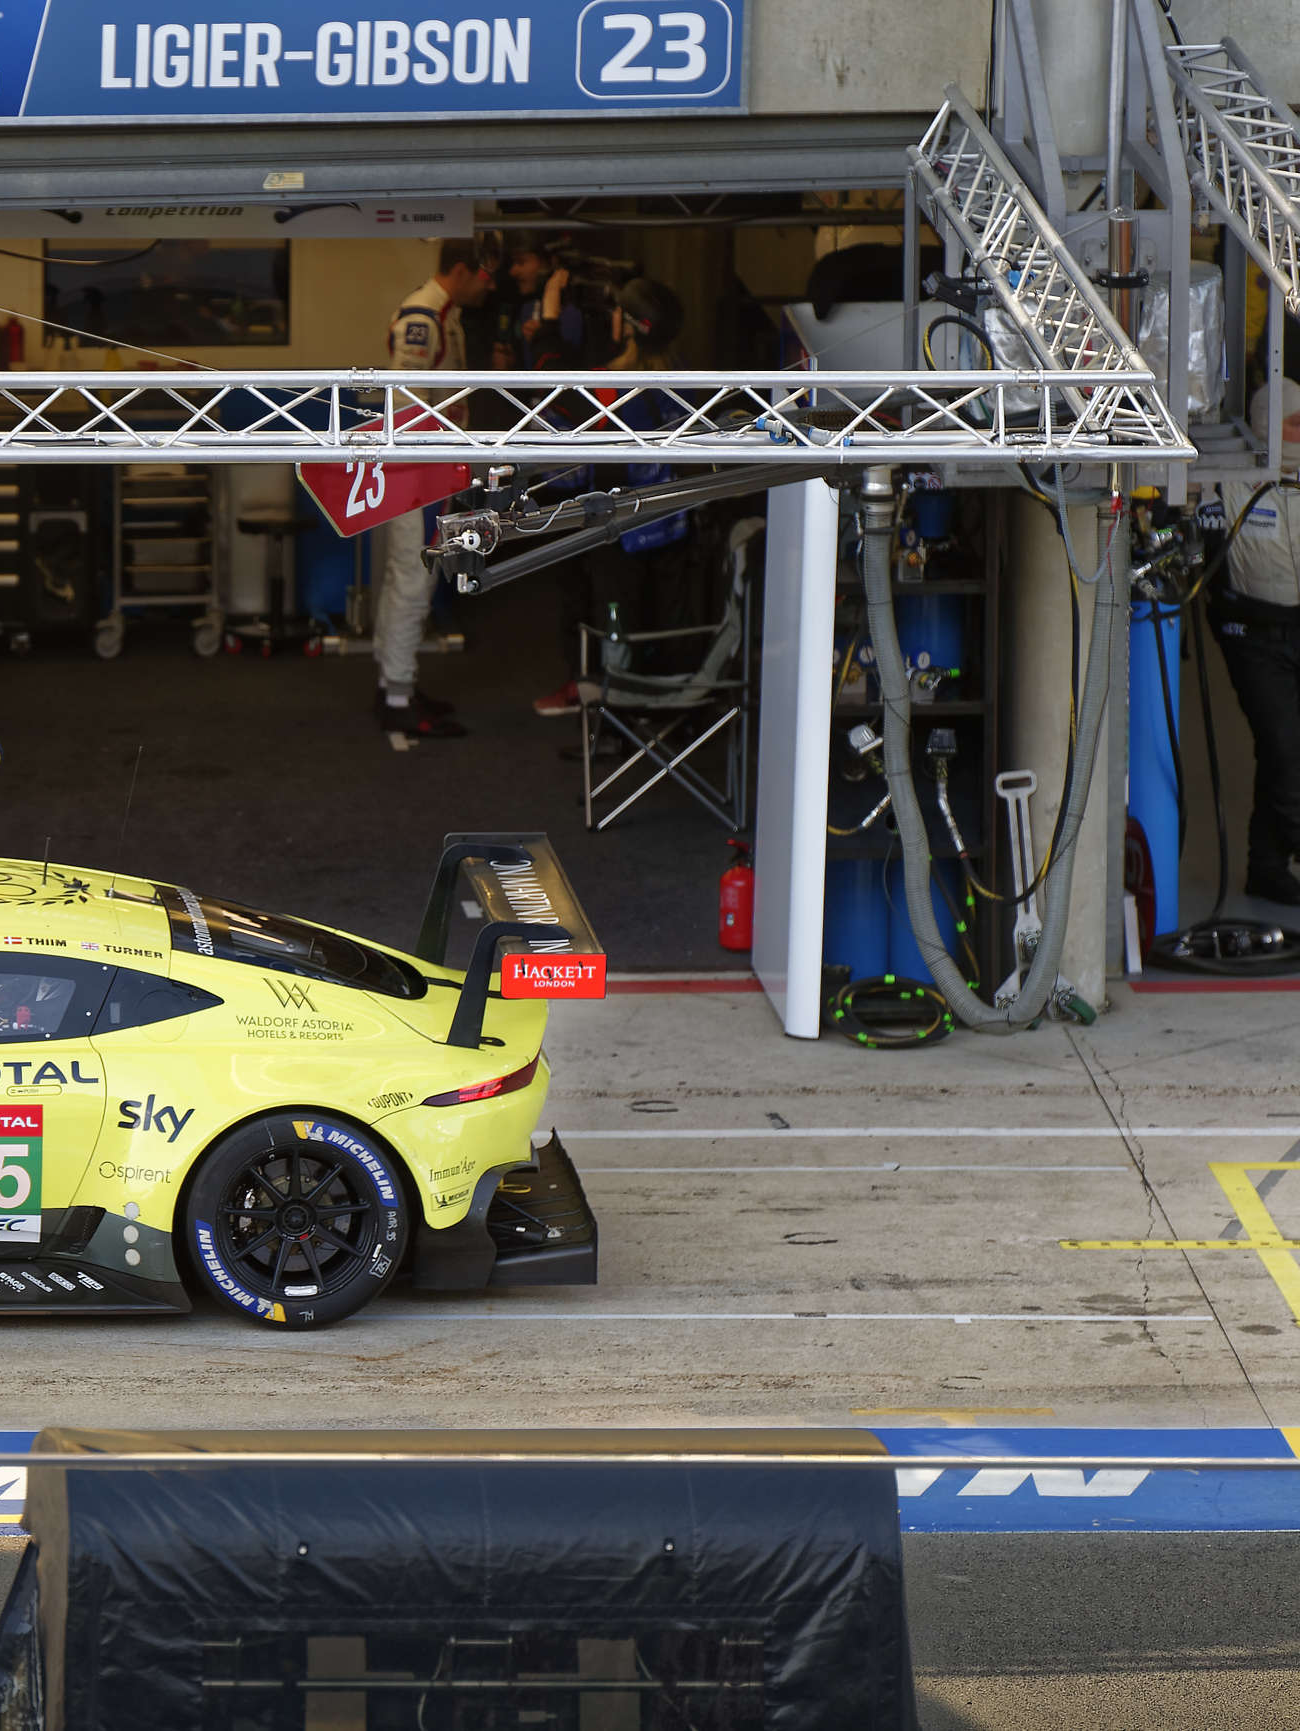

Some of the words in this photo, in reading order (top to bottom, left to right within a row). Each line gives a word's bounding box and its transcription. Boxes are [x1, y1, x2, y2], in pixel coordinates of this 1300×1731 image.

[100, 17, 532, 88] LIGIER-GIBSON
[599, 12, 707, 83] 23
[408, 324, 427, 343] 23
[345, 462, 386, 518] 23
[26, 937, 67, 947] THIIM
[103, 944, 164, 959] TURNER
[513, 964, 597, 979] HACKETT
[533, 980, 575, 988] LONDON
[236, 1015, 299, 1029] WALDORF
[301, 1018, 355, 1032] ASTORIA
[247, 1029, 287, 1039] HOTELS
[299, 1031, 344, 1041] RESORTS
[373, 1091, 410, 1109] DUPONT
[118, 1094, 196, 1142] sky
[117, 1163, 172, 1184] spirent
[327, 1131, 394, 1201] MICHELIN
[198, 1229, 255, 1307] MICHELIN
